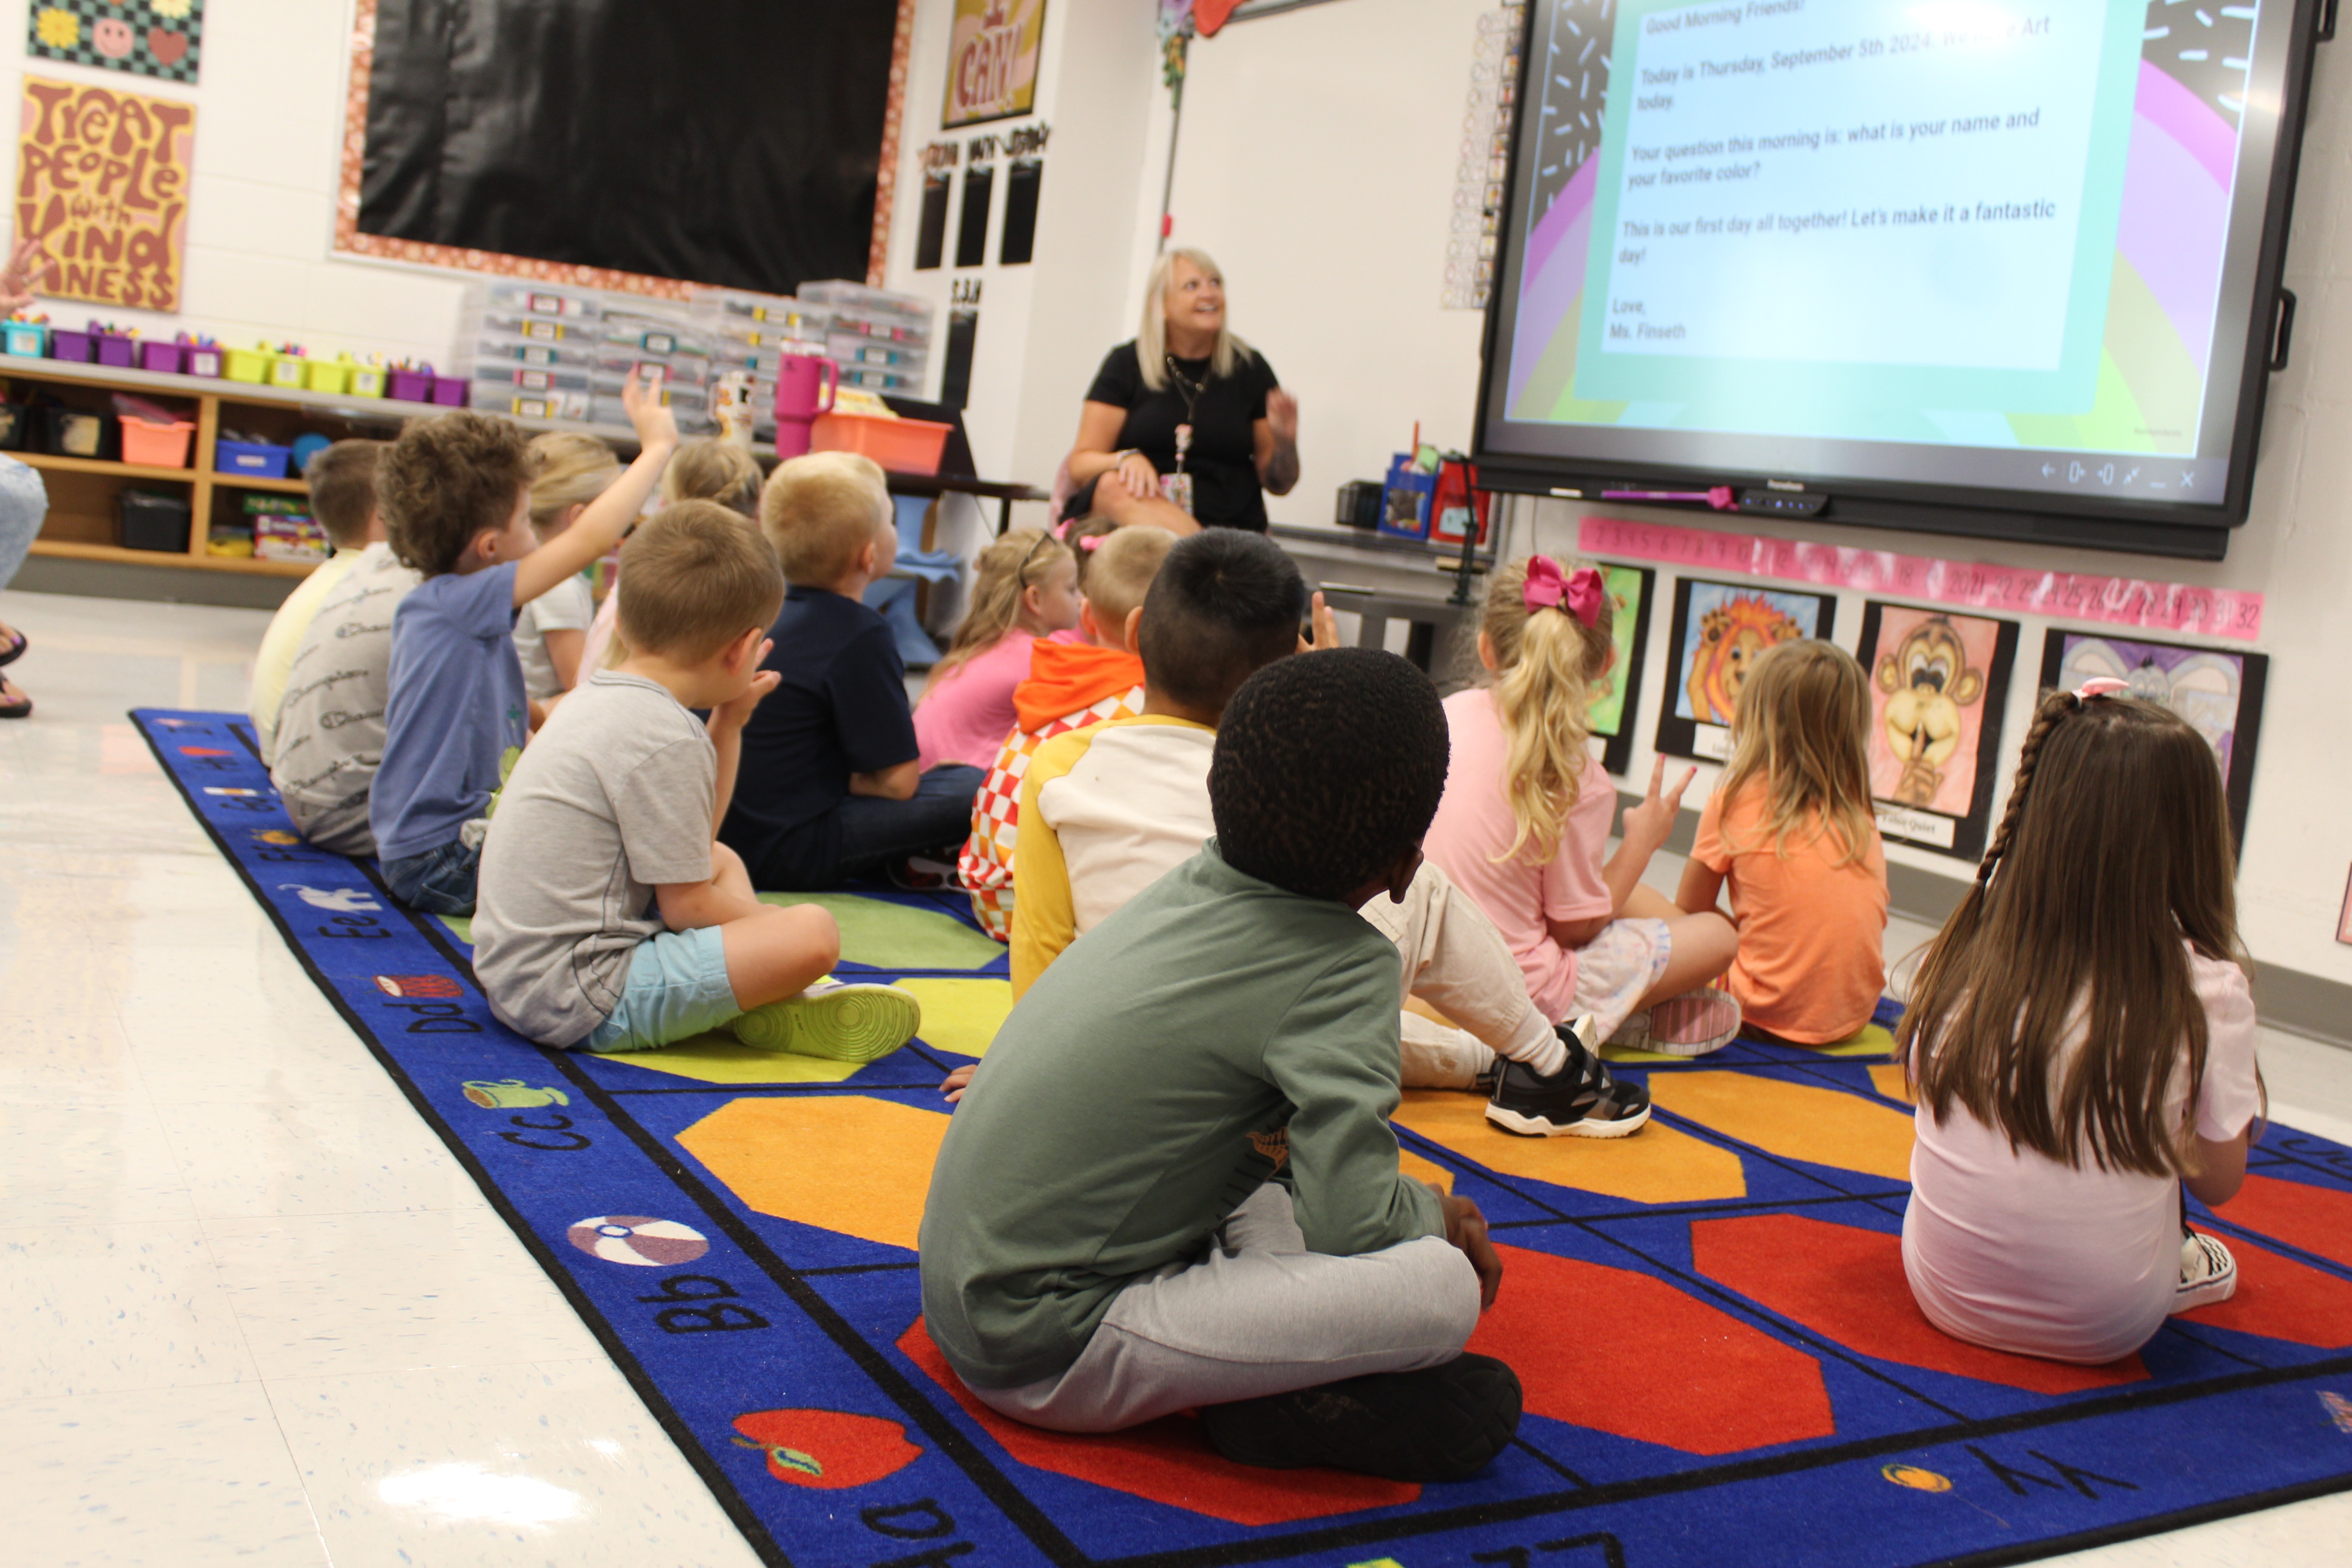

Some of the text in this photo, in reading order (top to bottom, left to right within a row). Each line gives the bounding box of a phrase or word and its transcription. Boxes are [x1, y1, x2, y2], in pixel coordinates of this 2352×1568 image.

[1646, 13, 1681, 35] Good
[1684, 6, 1742, 26] Morning
[1641, 68, 1678, 85] Today
[1683, 67, 1694, 79] is
[1699, 54, 1765, 78] Thursday,
[1771, 42, 1854, 70] September
[1859, 35, 1884, 57] 5th
[2021, 15, 2050, 36] Art
[1637, 93, 1674, 111] today.
[1632, 106, 2041, 162] Your question this morning is: what is your name and
[1627, 160, 1761, 192] your favorite color?
[1622, 198, 2056, 238] This is our first day all together! Let's make it a fantastic
[1618, 246, 1647, 265] day!
[1612, 296, 1646, 315] Love,
[1637, 321, 1686, 339] Finseth
[1660, 532, 1670, 554] 6
[1948, 569, 1970, 594] 20
[1970, 572, 1985, 596] 21
[2063, 582, 2084, 607] 25
[2087, 584, 2106, 611] 26
[2236, 602, 2260, 630] 32
[317, 913, 393, 941] Ee
[382, 1001, 484, 1034] Dd
[497, 1114, 593, 1152] Cc
[637, 1273, 770, 1334] Bb
